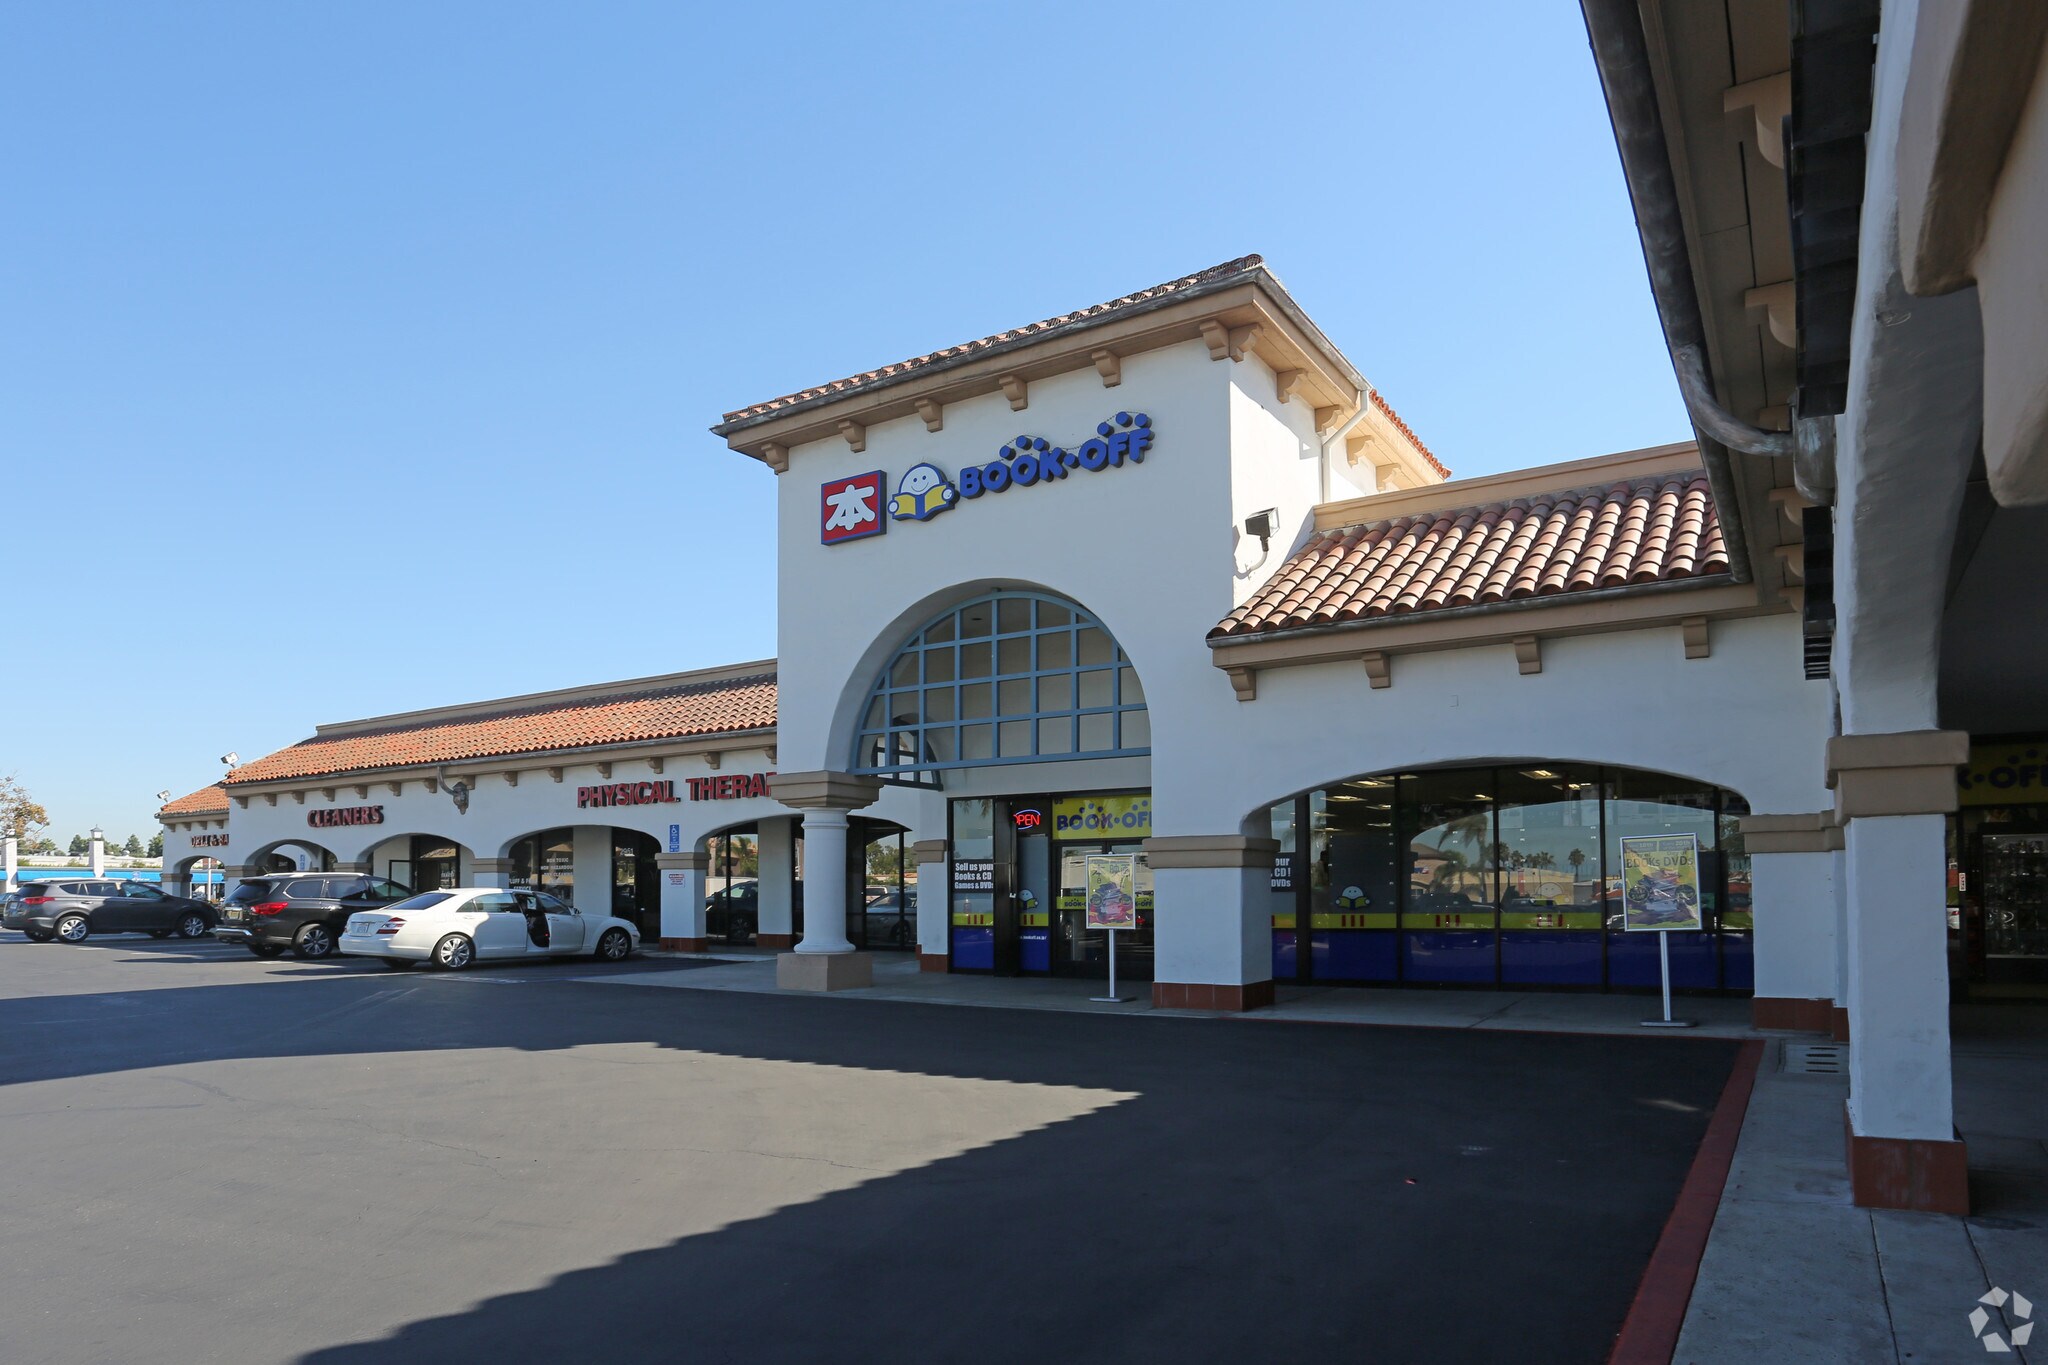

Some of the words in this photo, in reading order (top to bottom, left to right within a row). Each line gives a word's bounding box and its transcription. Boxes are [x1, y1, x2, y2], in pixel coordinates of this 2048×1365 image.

[825, 484, 876, 531] 本
[577, 780, 678, 808] PHYSICAL
[307, 805, 384, 827] CLEANERS
[954, 872, 975, 881] Books
[955, 863, 969, 871] Sell
